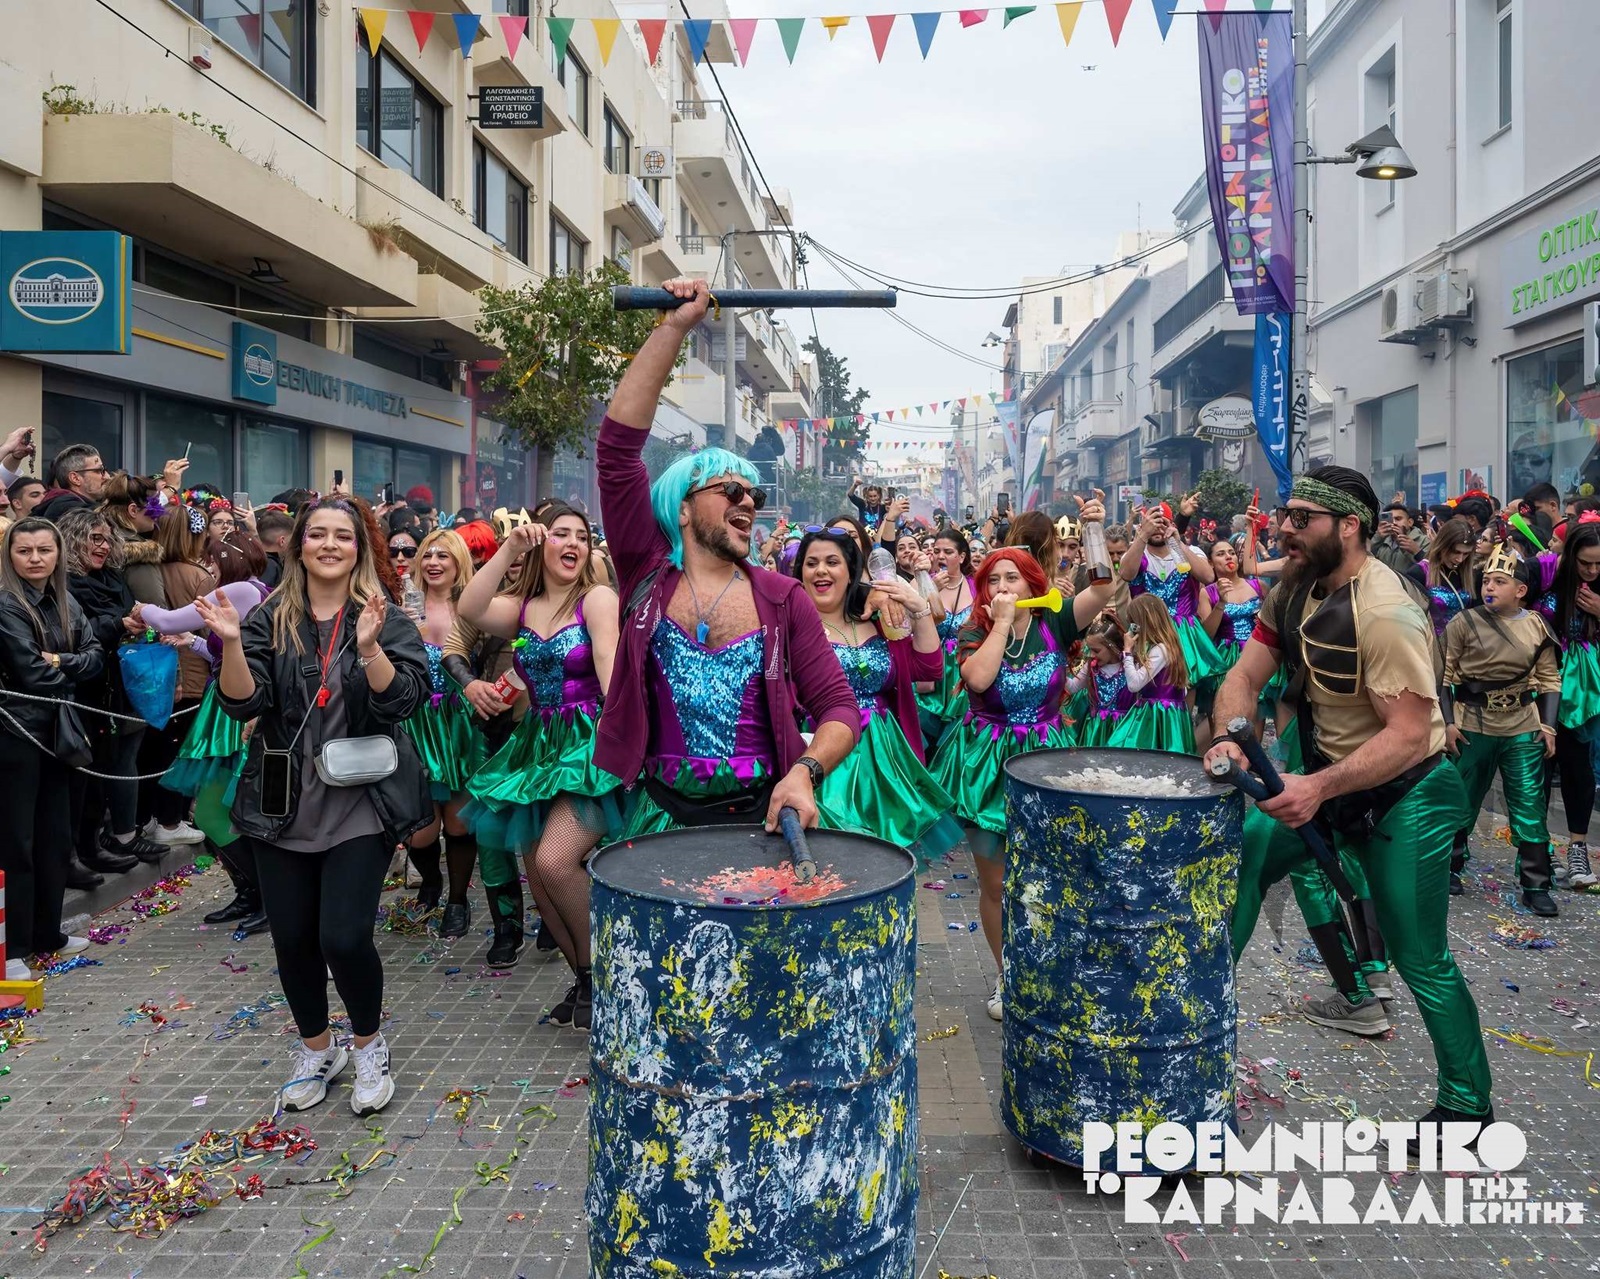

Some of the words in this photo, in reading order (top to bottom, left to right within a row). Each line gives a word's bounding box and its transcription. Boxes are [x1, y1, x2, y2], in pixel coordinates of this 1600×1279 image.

[489, 104, 532, 112] ΛΟΓΙΣΤΙΚΟ
[492, 112, 529, 120] ΓΡΑΦΕΙΟ
[1249, 98, 1272, 265] ΚΑΡΝΑΒΑΛΙ
[1538, 209, 1600, 263] ΟΠΤΙΚ
[1256, 266, 1267, 286] ΤΟ
[1511, 253, 1600, 314] ΣΤΑΓΚΟΥΡ
[276, 359, 342, 403] ΕΘΝΙΚΗ
[342, 379, 407, 419] ΤΡΑΠΕΖΑ
